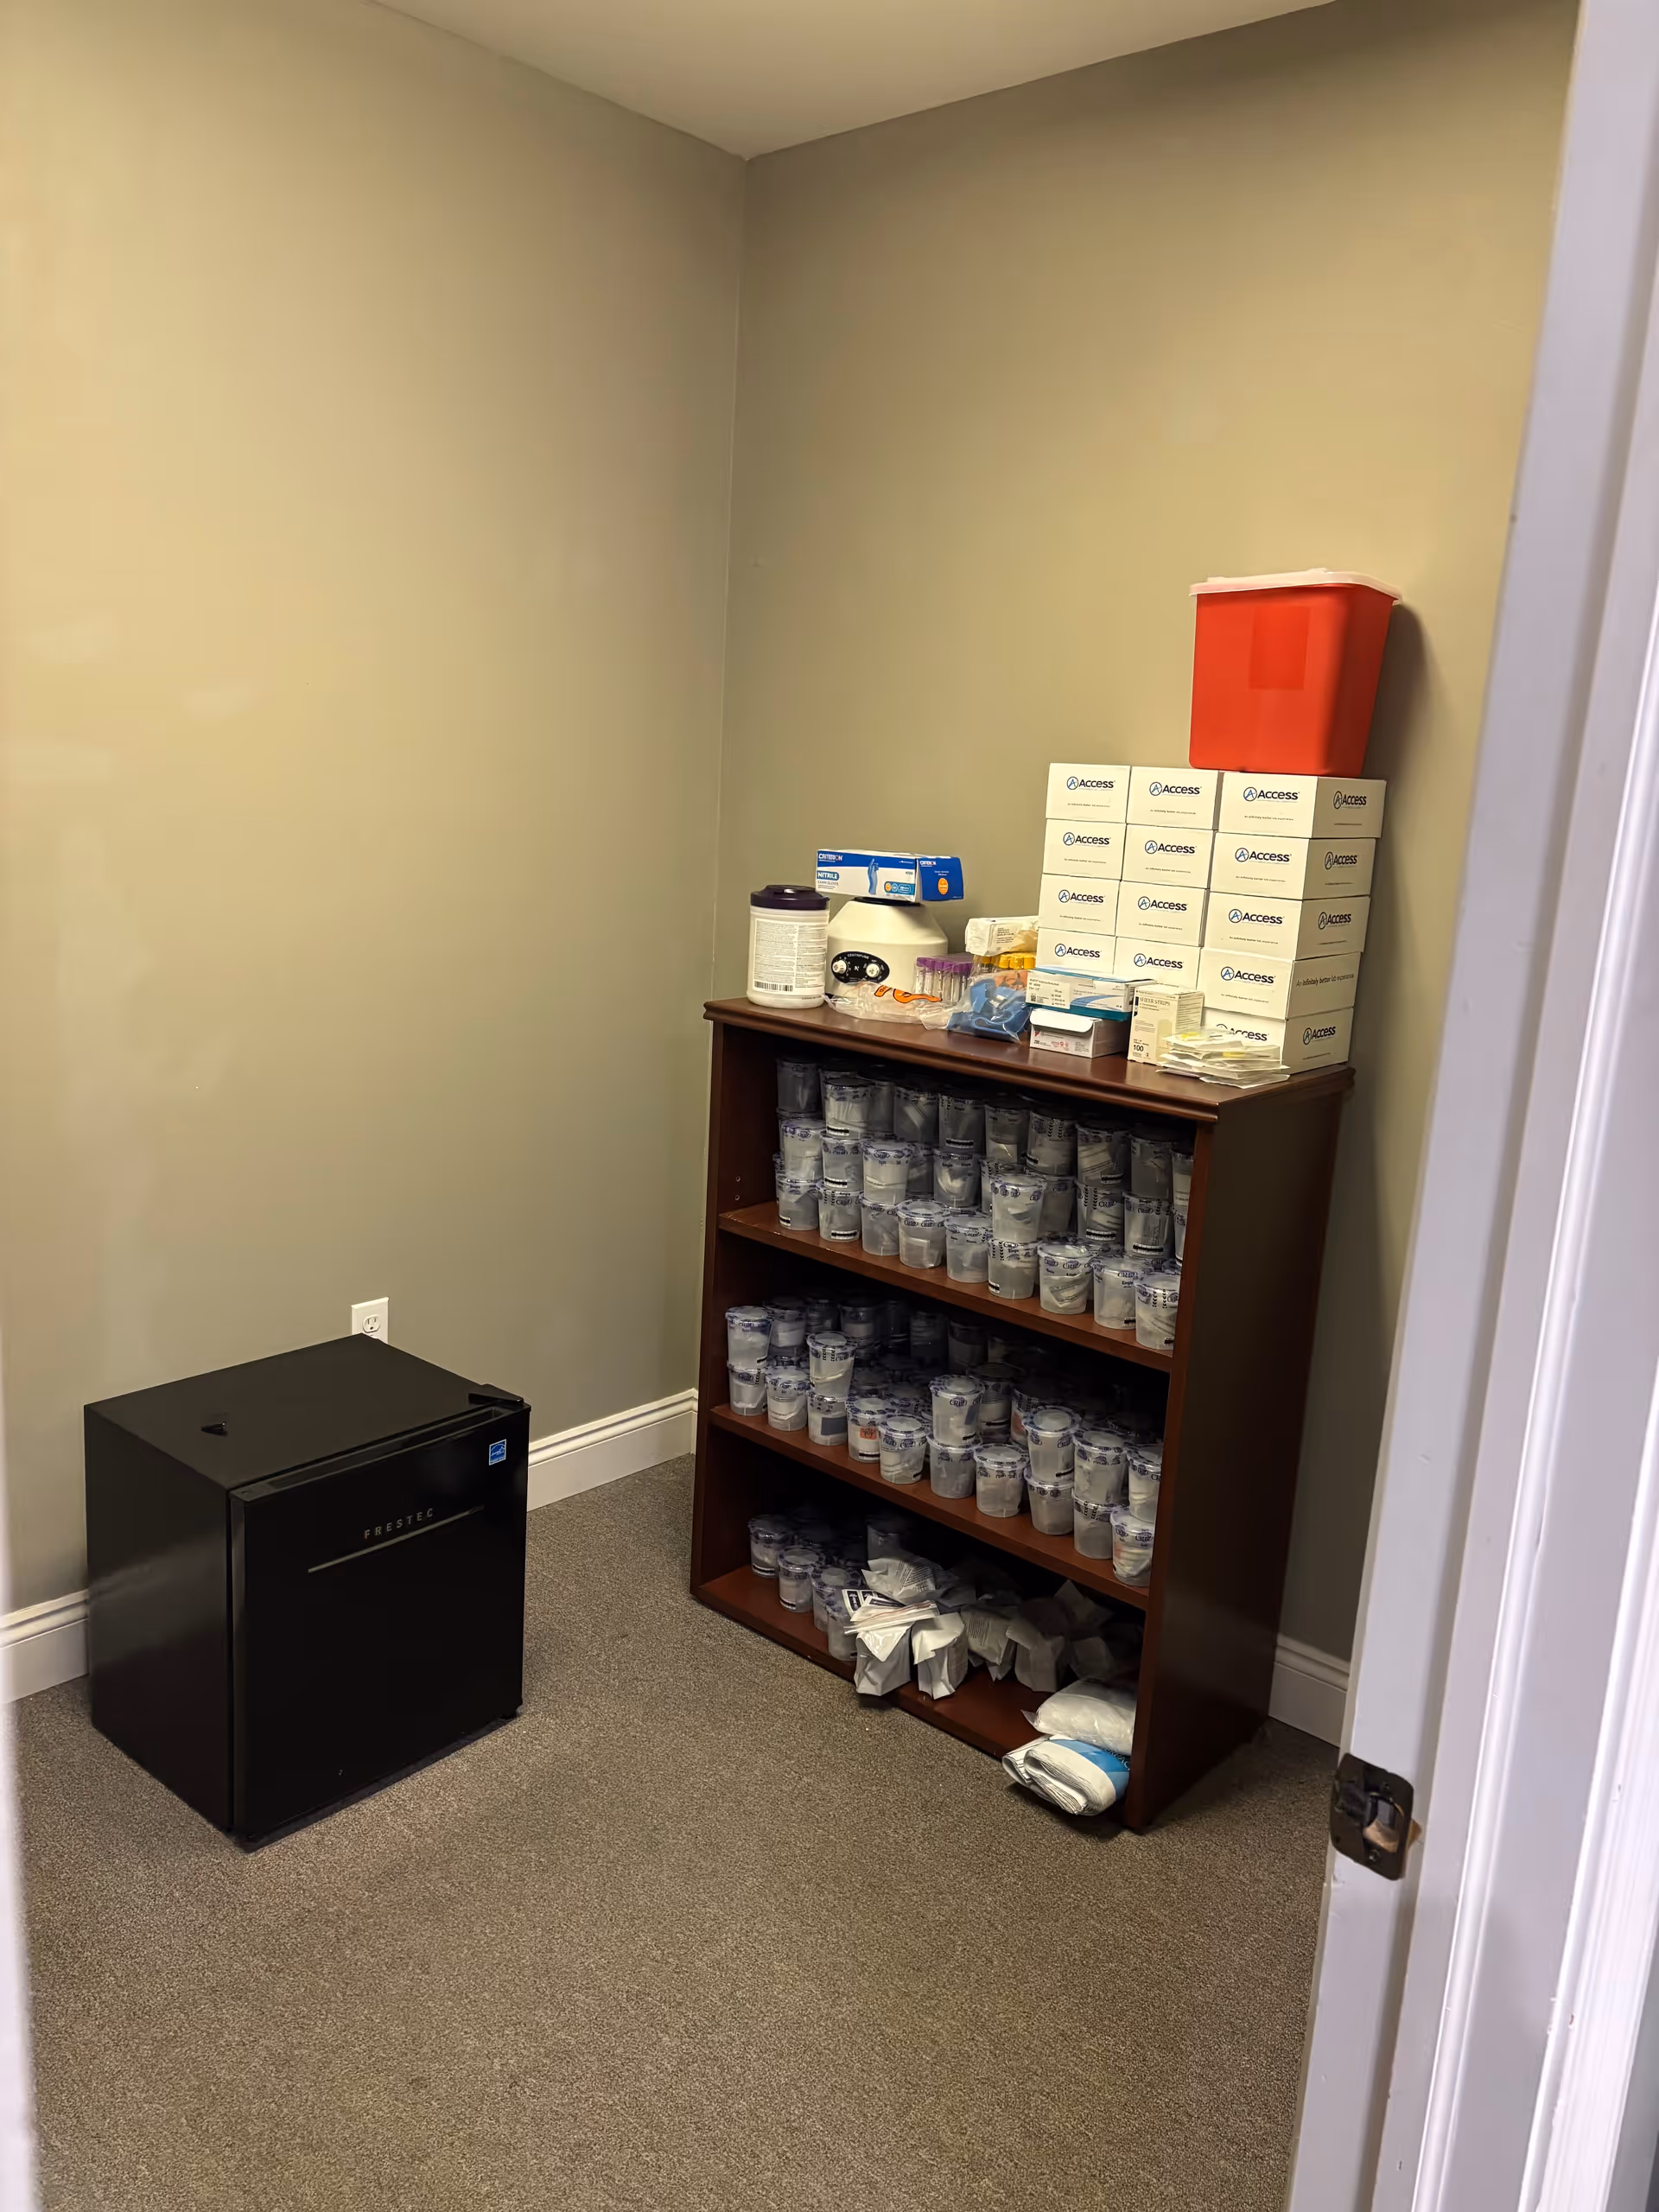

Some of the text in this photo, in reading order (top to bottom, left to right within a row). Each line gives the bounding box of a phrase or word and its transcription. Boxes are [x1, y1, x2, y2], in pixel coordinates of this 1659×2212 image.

[1079, 779, 1113, 788] Access
[1163, 785, 1199, 794] Access
[1258, 791, 1298, 800] Access
[1343, 795, 1366, 805] Access
[1075, 836, 1109, 844] Access
[1158, 843, 1195, 854] Access
[1249, 851, 1289, 861] Access
[1333, 855, 1357, 865] Access
[817, 871, 838, 880] NITRILE
[1071, 893, 1103, 903] Access
[1151, 900, 1186, 911] Access
[1243, 912, 1282, 924] Access
[1327, 914, 1351, 925] Access
[1066, 947, 1100, 957] Access
[1147, 957, 1182, 969] Access
[1235, 971, 1274, 983] Access
[1313, 1027, 1336, 1039] Access
[364, 1508, 433, 1540] FRESTEC
